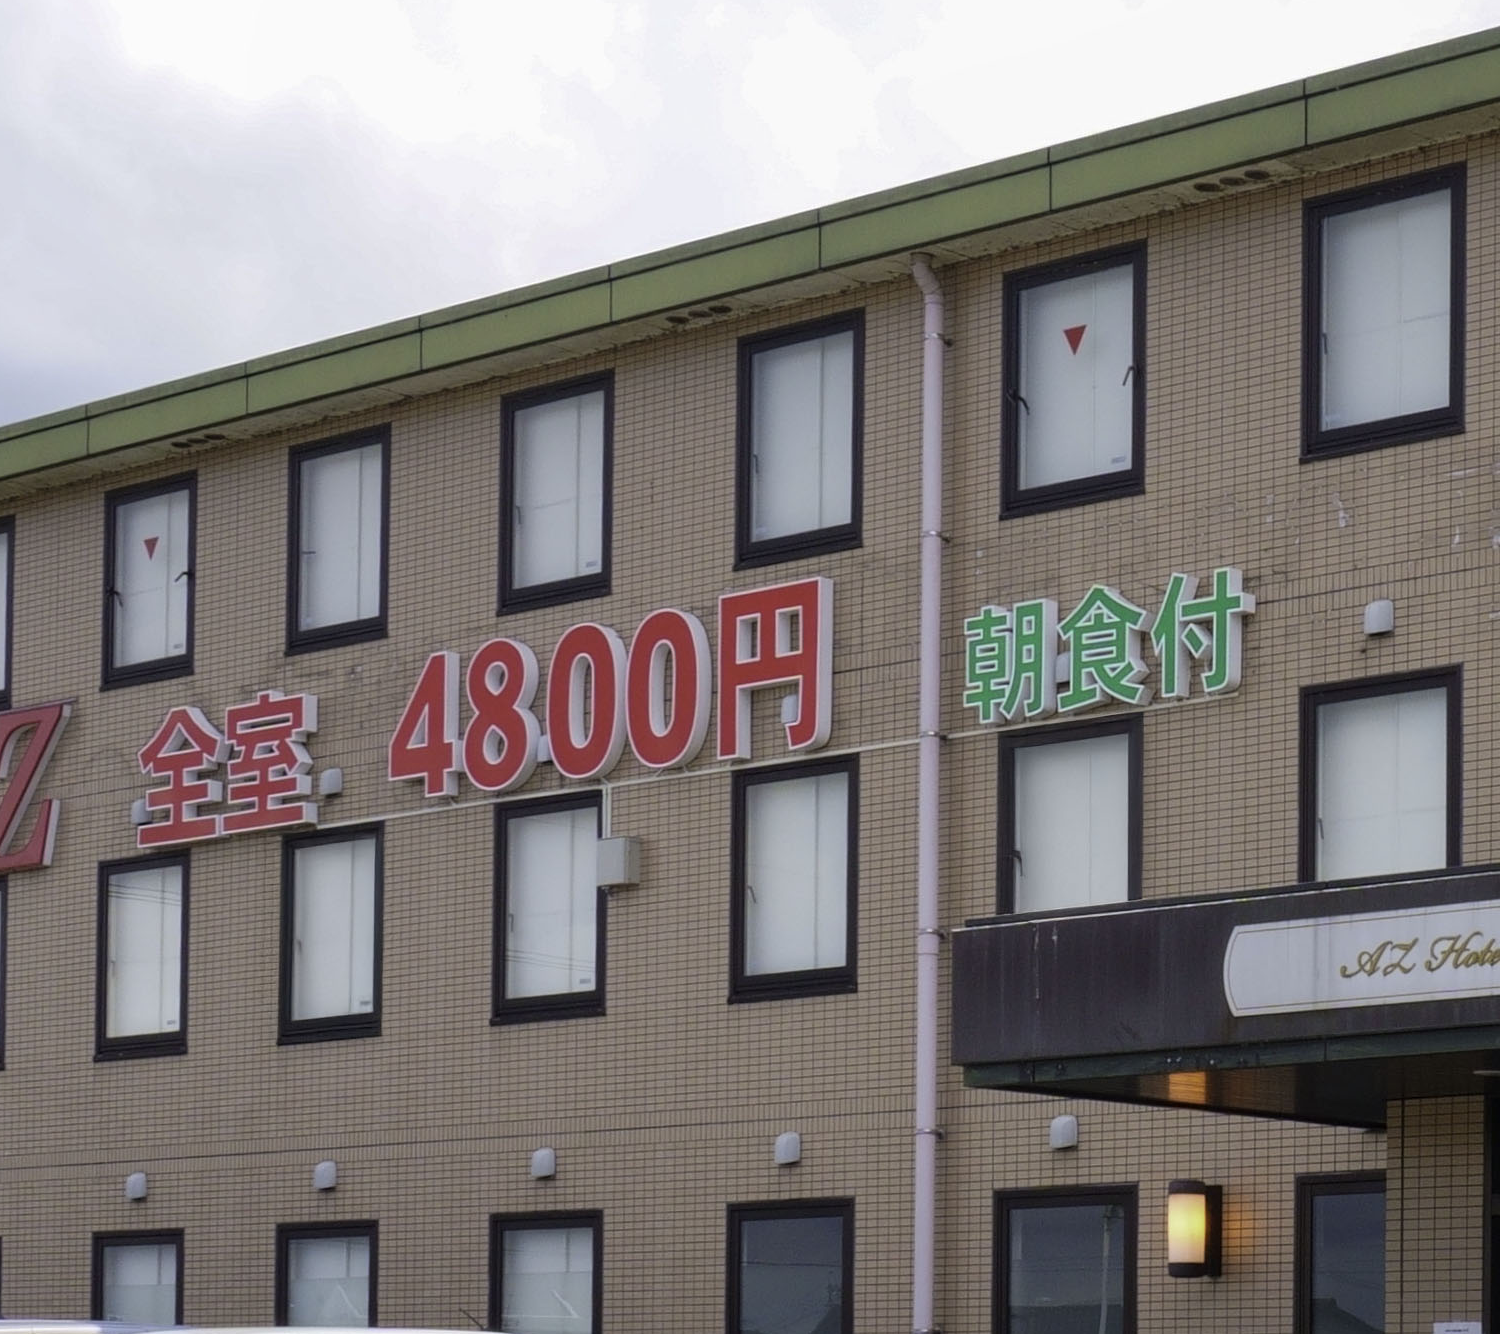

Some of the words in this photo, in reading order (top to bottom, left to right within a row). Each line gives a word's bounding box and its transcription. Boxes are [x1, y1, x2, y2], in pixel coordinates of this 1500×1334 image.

[136, 690, 318, 848] 全室
[388, 576, 834, 797] 4800円
[962, 566, 1255, 725] 朝食付
[1339, 936, 1419, 979] AZ
